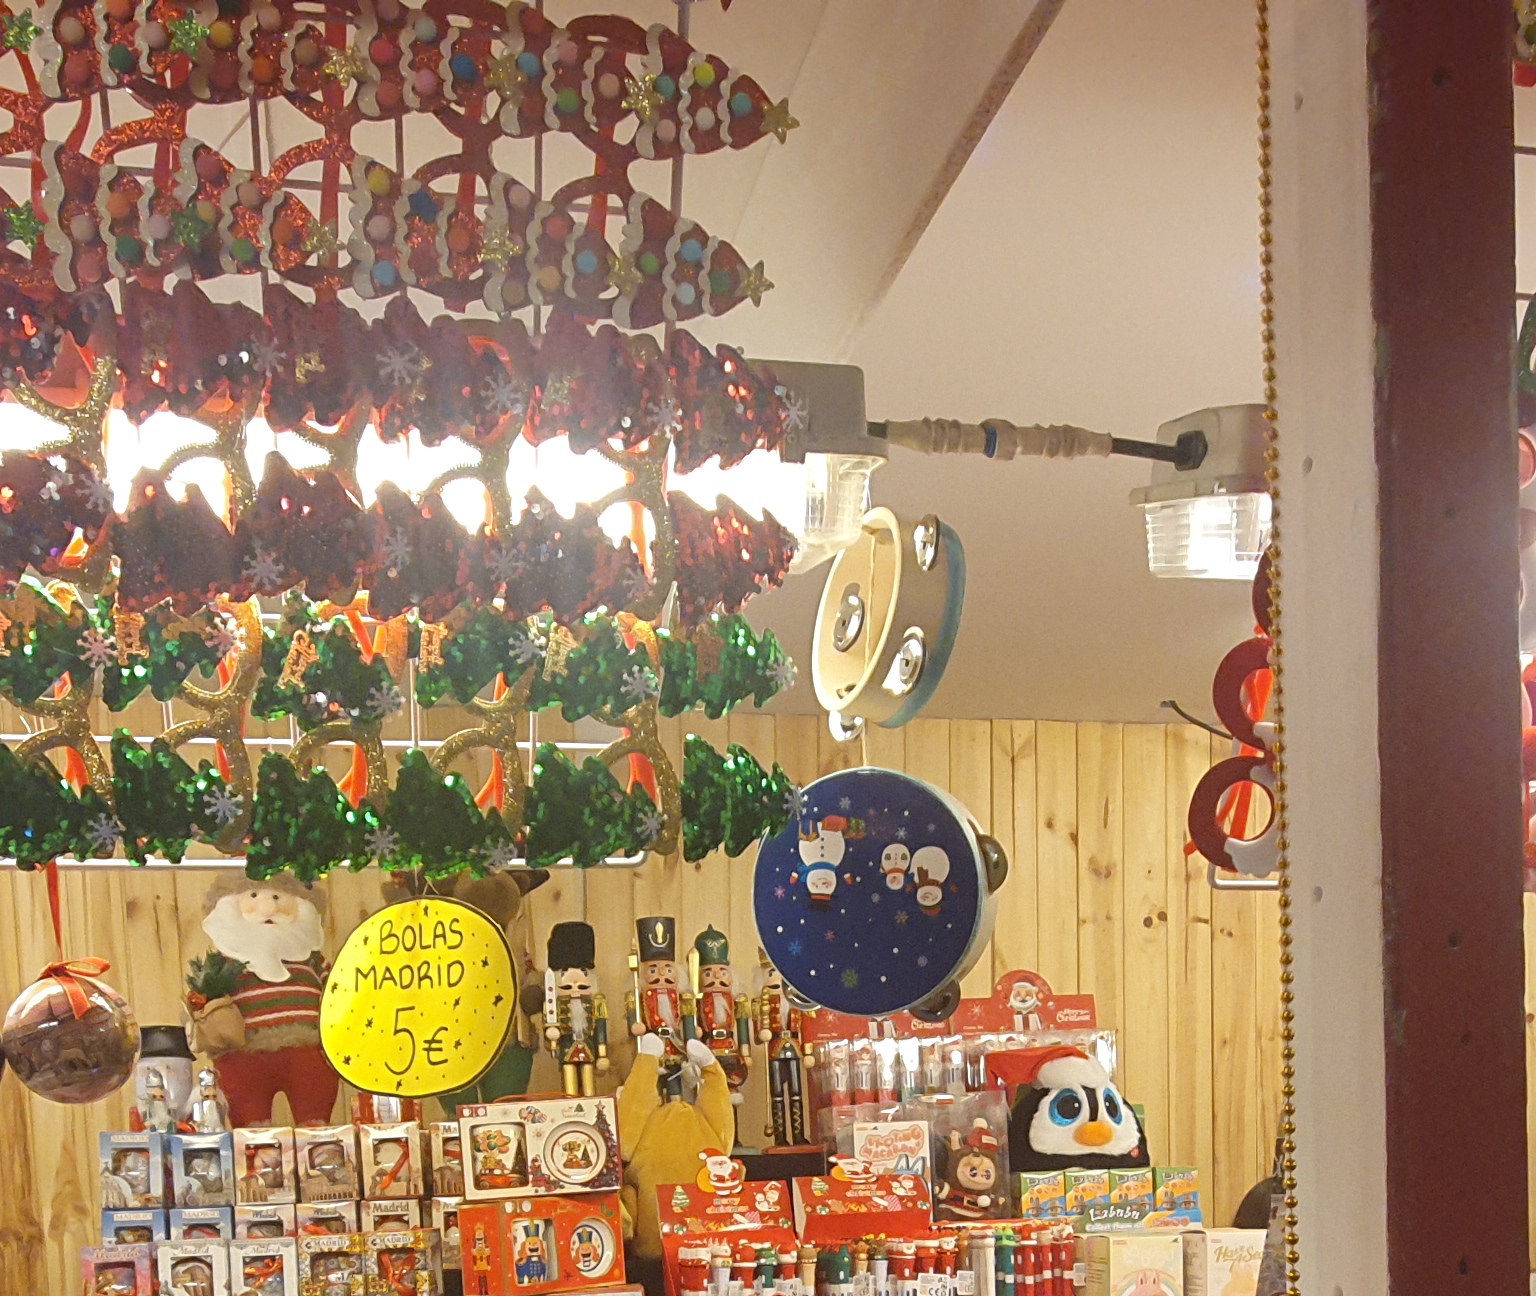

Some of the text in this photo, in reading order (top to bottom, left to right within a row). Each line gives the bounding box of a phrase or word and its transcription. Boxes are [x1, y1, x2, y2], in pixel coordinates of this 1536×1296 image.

[378, 917, 463, 956] BOLAS
[353, 958, 465, 990] MADRID
[383, 1005, 449, 1076] 5€
[1088, 1205, 1141, 1222] Labubu
